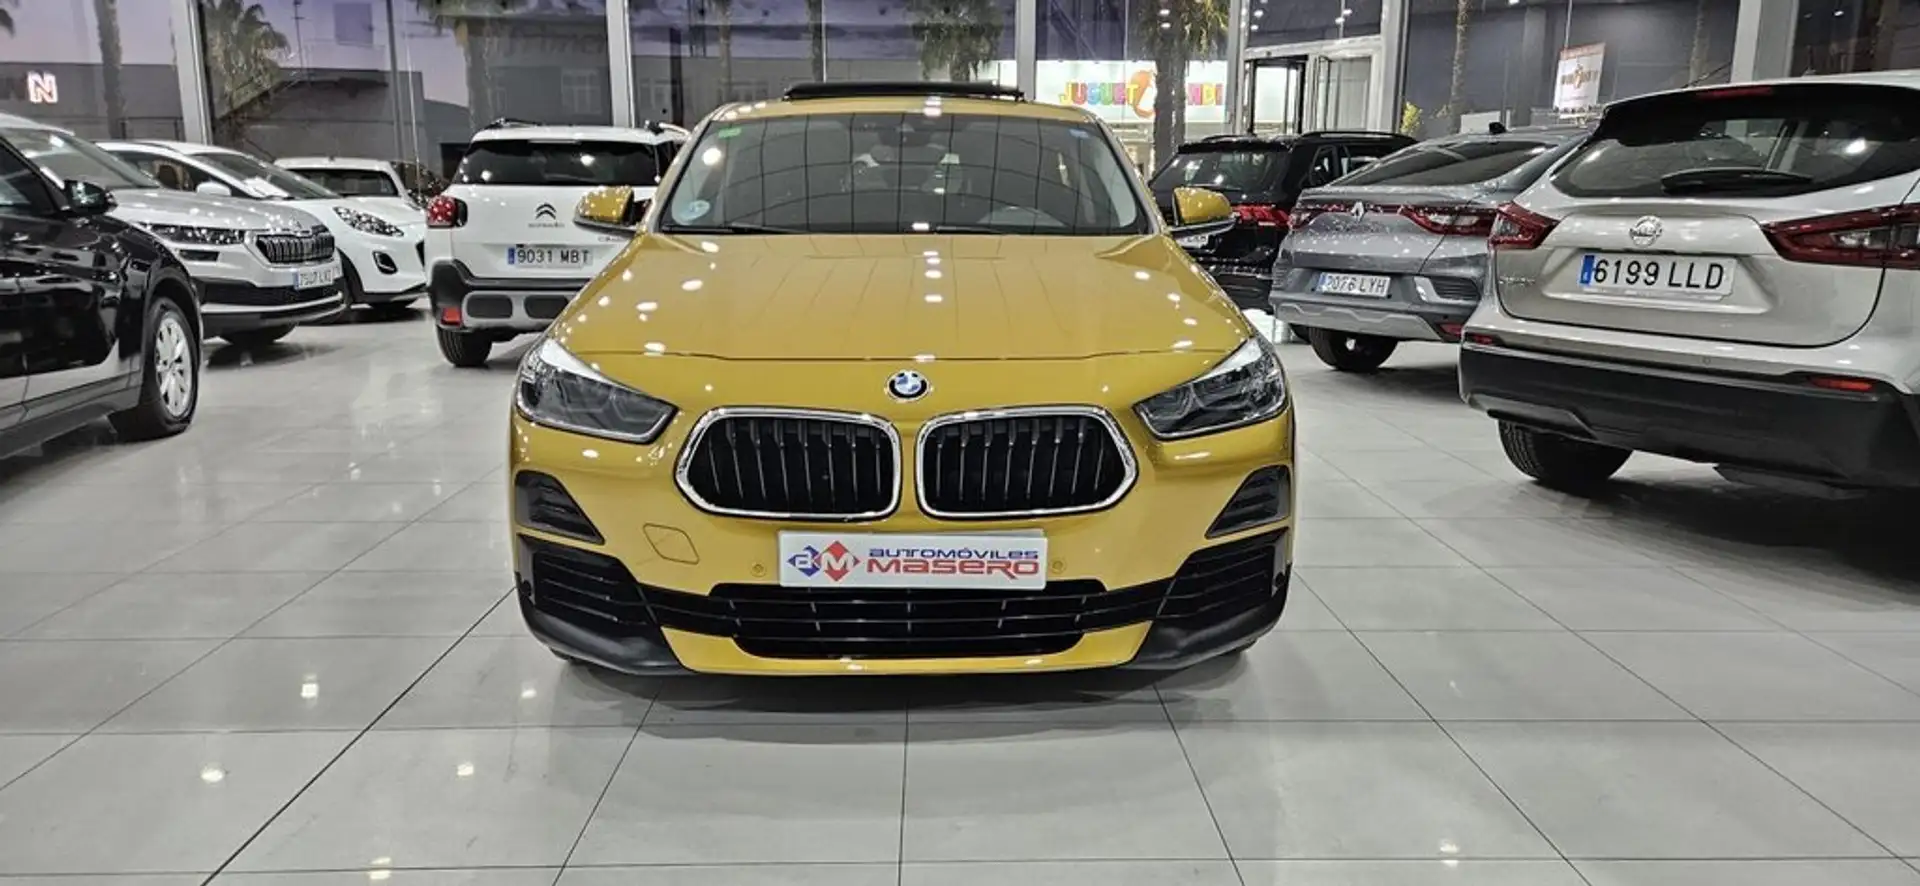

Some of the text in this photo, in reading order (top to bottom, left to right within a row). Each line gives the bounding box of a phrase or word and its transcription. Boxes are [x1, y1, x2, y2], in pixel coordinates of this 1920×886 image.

[517, 249, 590, 265] 9031 MBT
[1593, 258, 1724, 290] 6199 LLD
